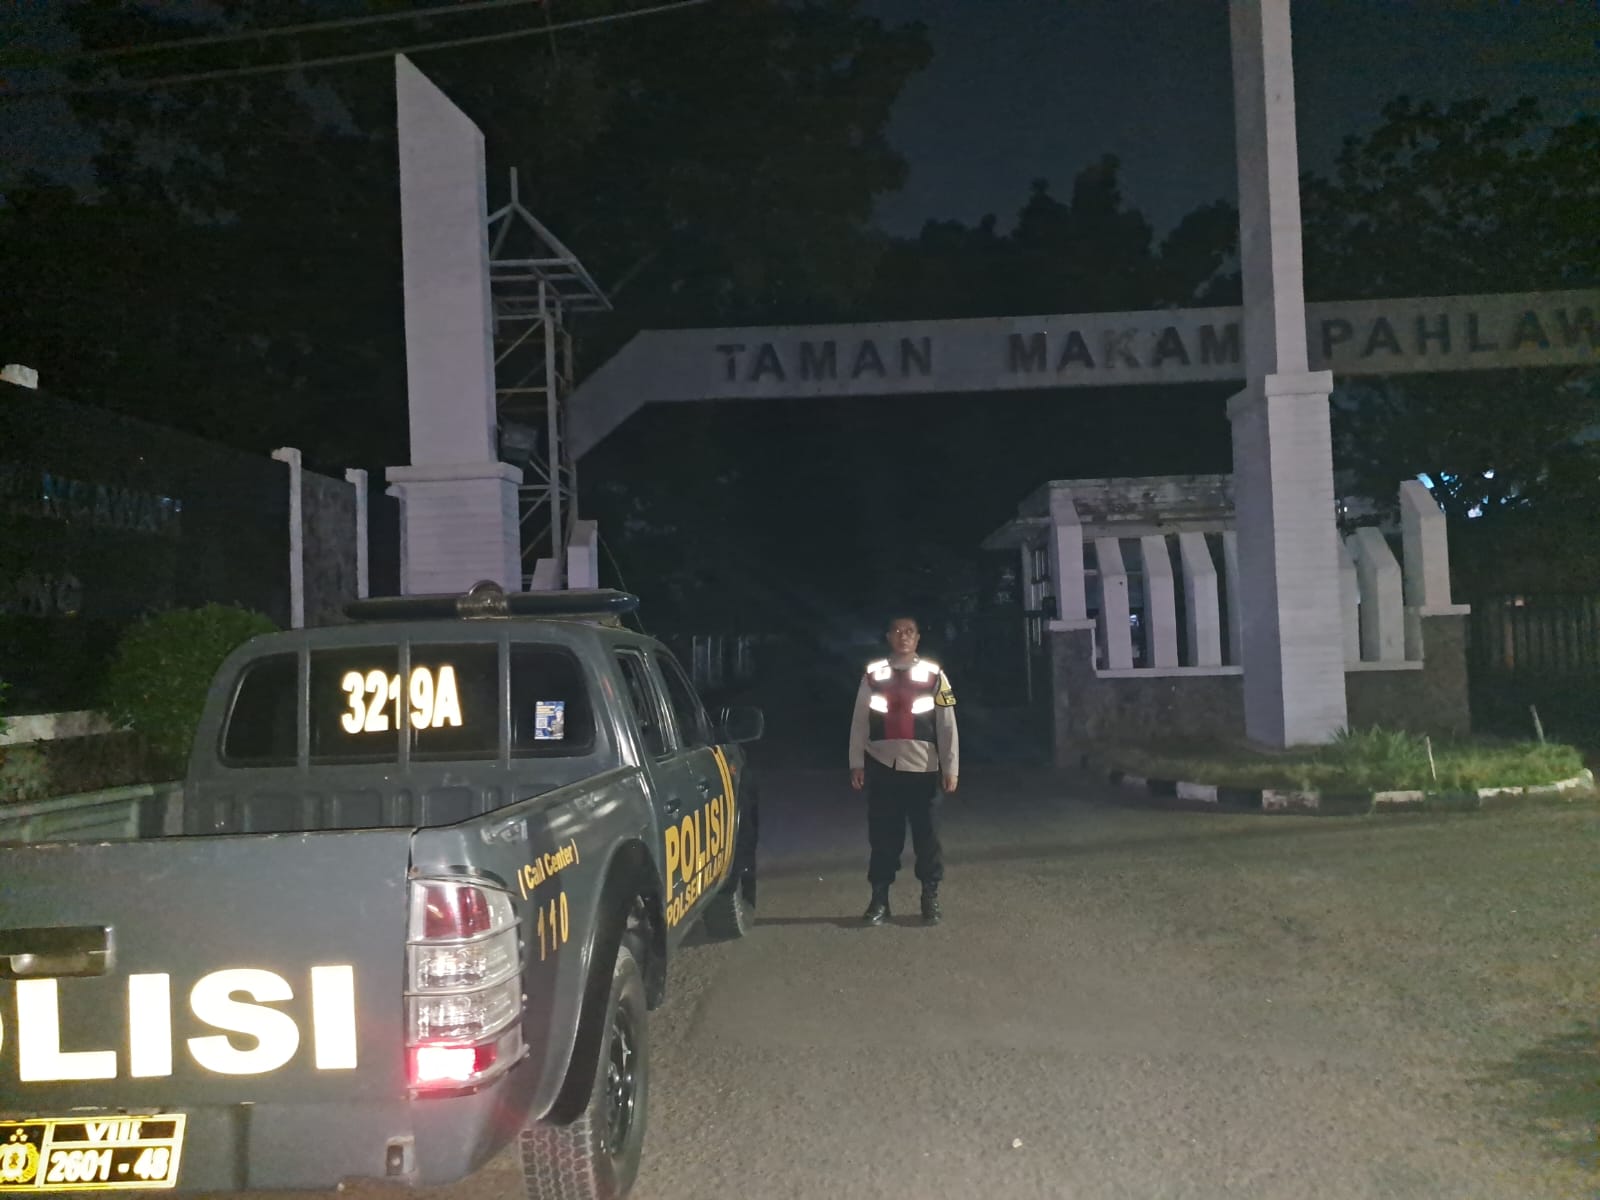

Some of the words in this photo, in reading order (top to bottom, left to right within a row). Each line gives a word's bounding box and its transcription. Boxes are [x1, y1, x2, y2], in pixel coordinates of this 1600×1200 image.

[716, 336, 931, 382] TAMAN
[1007, 325, 1241, 374] MAKAM
[341, 665, 463, 734] 3219A
[664, 794, 725, 904] POLISI
[537, 891, 569, 961] 110
[0, 965, 358, 1082] LISI
